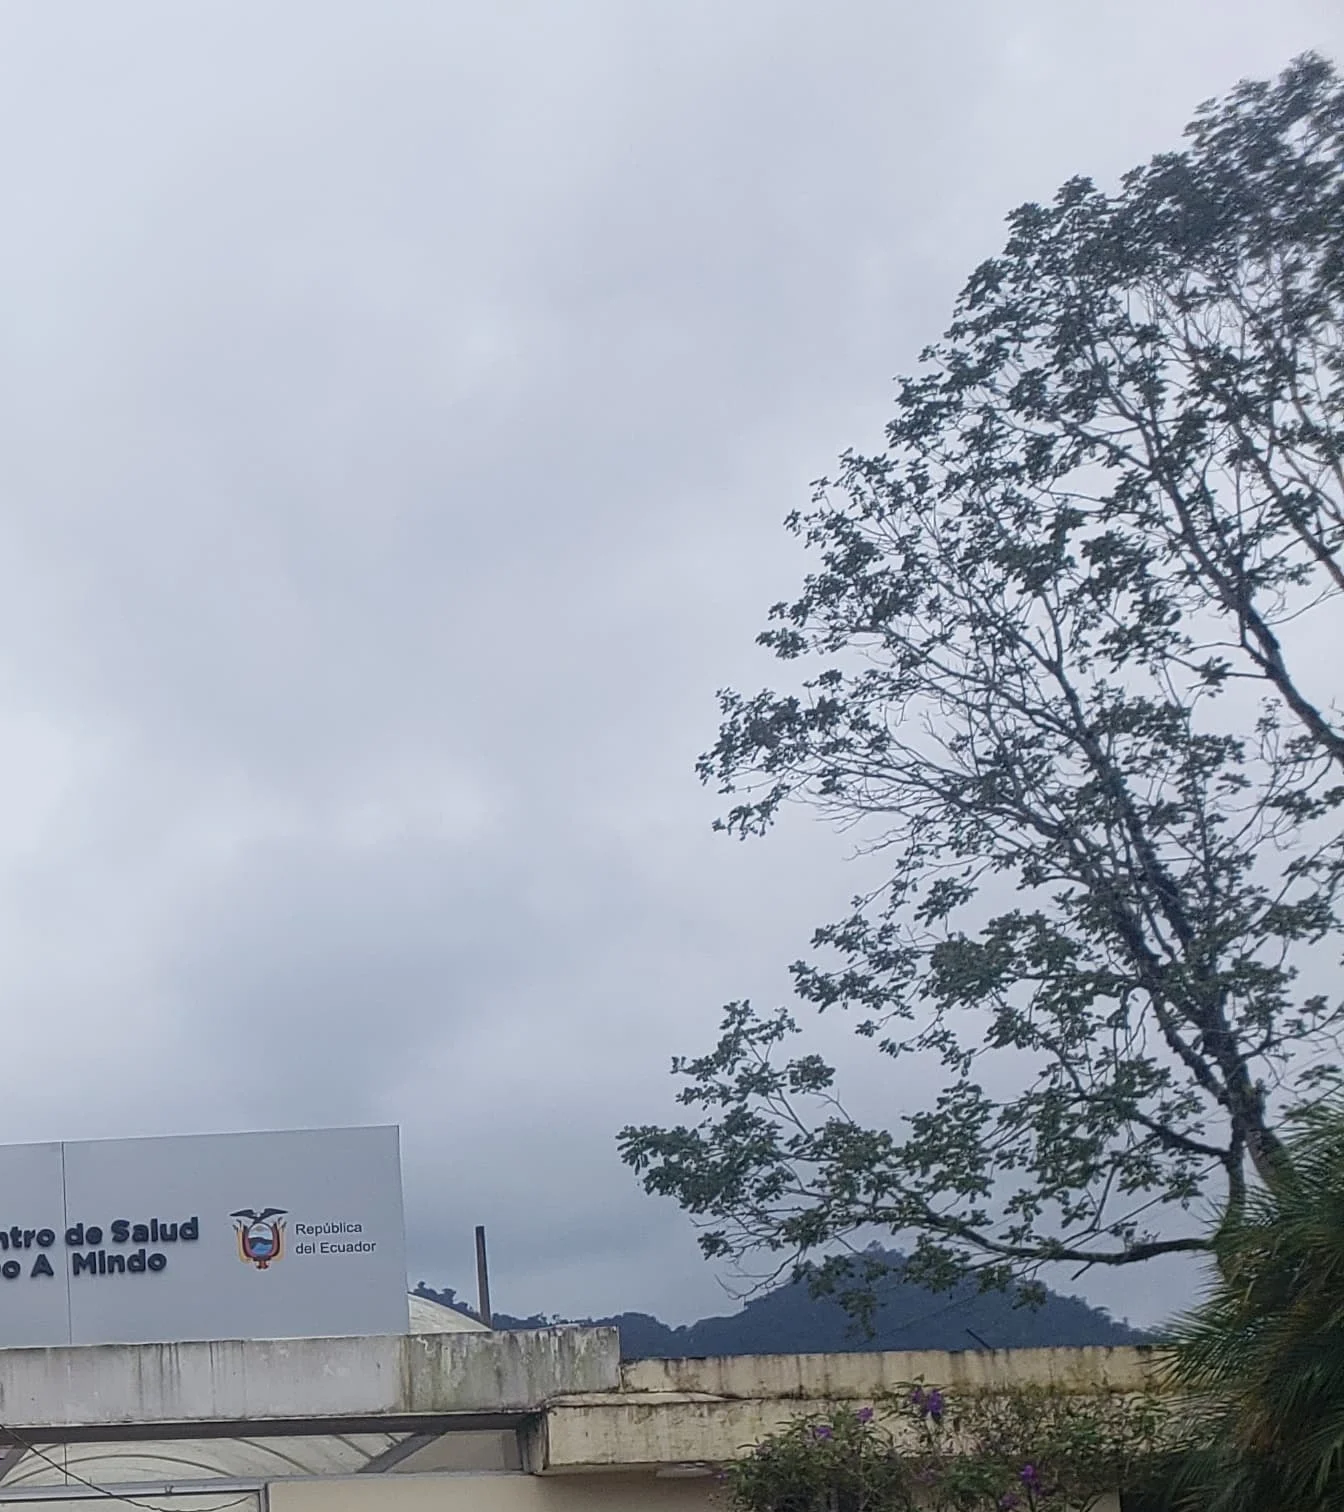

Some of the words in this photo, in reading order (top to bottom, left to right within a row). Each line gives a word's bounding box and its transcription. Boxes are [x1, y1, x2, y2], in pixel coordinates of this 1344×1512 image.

[65, 1222, 103, 1246] de
[111, 1216, 199, 1242] Salud
[295, 1222, 362, 1236] República
[295, 1241, 316, 1254] del
[320, 1240, 377, 1253] Ecuador
[30, 1253, 54, 1278] A
[72, 1248, 167, 1276] Mindo
